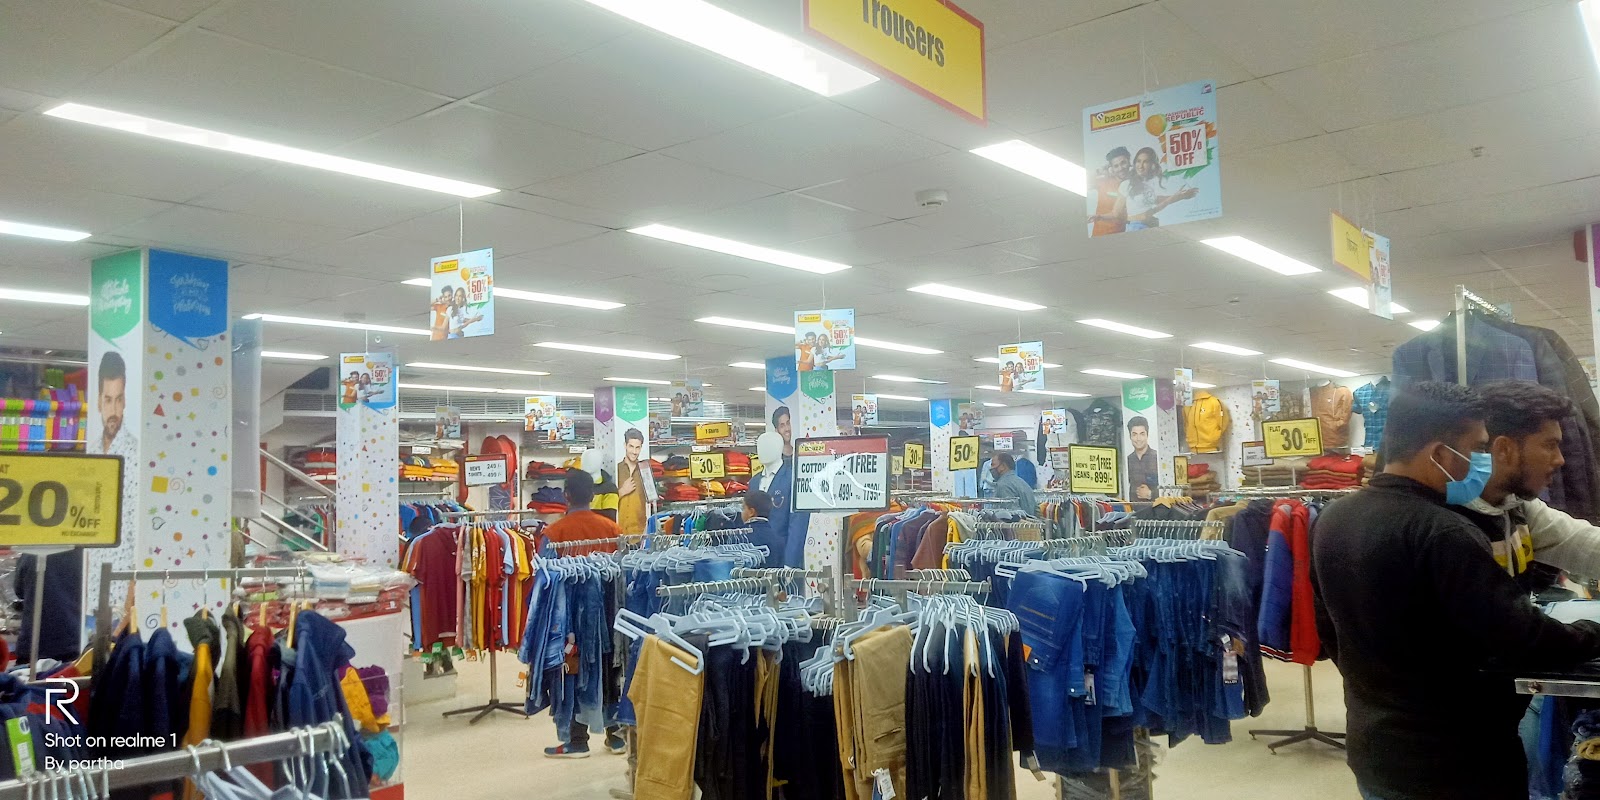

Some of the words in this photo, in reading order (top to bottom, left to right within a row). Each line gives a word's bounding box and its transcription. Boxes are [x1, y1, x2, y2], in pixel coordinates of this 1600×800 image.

[1104, 110, 1136, 124] baazar
[1169, 129, 1203, 155] 50%
[1175, 151, 1195, 167] OFF
[471, 279, 487, 294] 50%
[1281, 427, 1303, 451] 30
[909, 448, 918, 465] 30
[953, 443, 971, 463] 50
[700, 458, 713, 474] 30
[855, 454, 878, 473] FREE
[1101, 457, 1112, 470] FREE
[1073, 470, 1090, 479] JEANS
[797, 477, 830, 493] TRORS
[0, 477, 69, 528] 20
